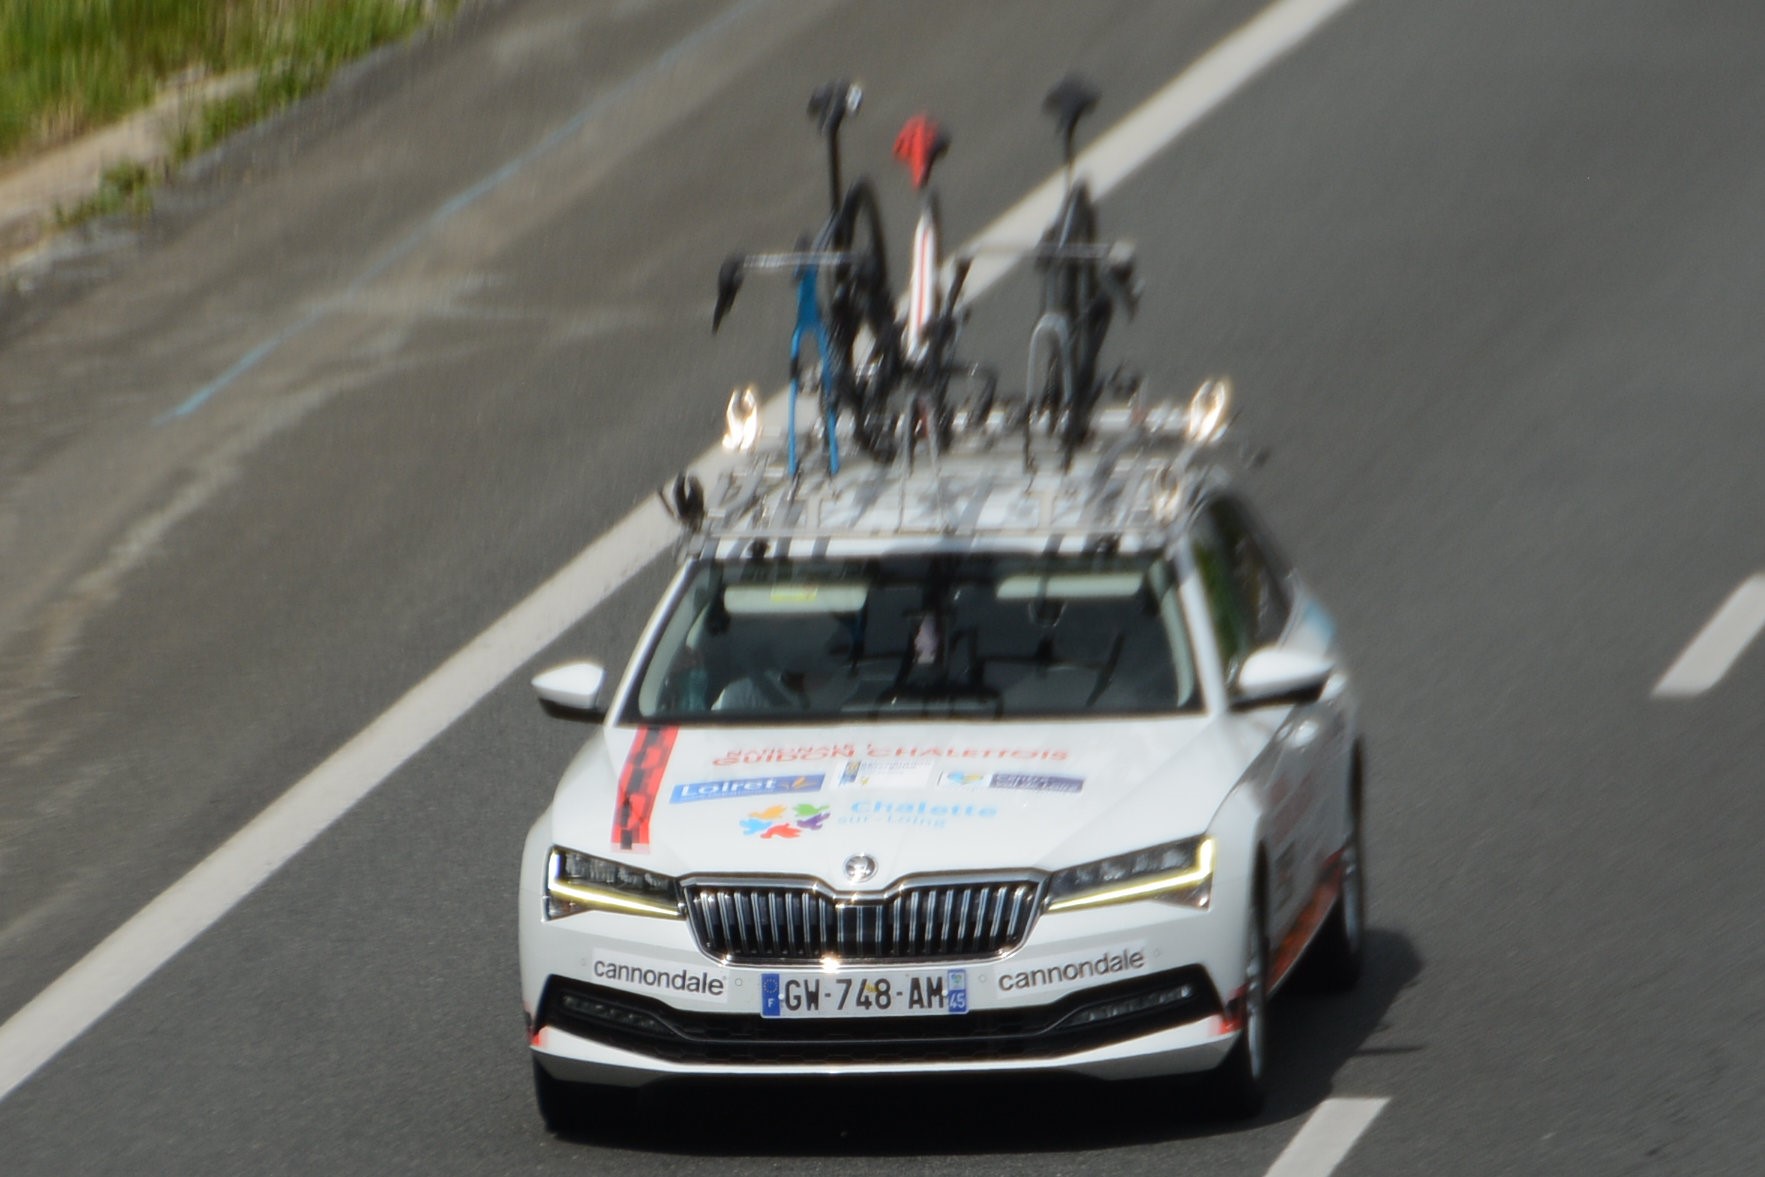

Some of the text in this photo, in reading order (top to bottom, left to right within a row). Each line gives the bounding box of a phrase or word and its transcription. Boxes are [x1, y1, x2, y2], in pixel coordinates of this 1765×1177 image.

[681, 777, 777, 797] Loiret
[594, 960, 724, 996] cannondale
[998, 948, 1145, 991] cannondale
[767, 998, 775, 1008] F
[784, 977, 945, 1011] GW-748-AM
[949, 994, 966, 1009] 45
